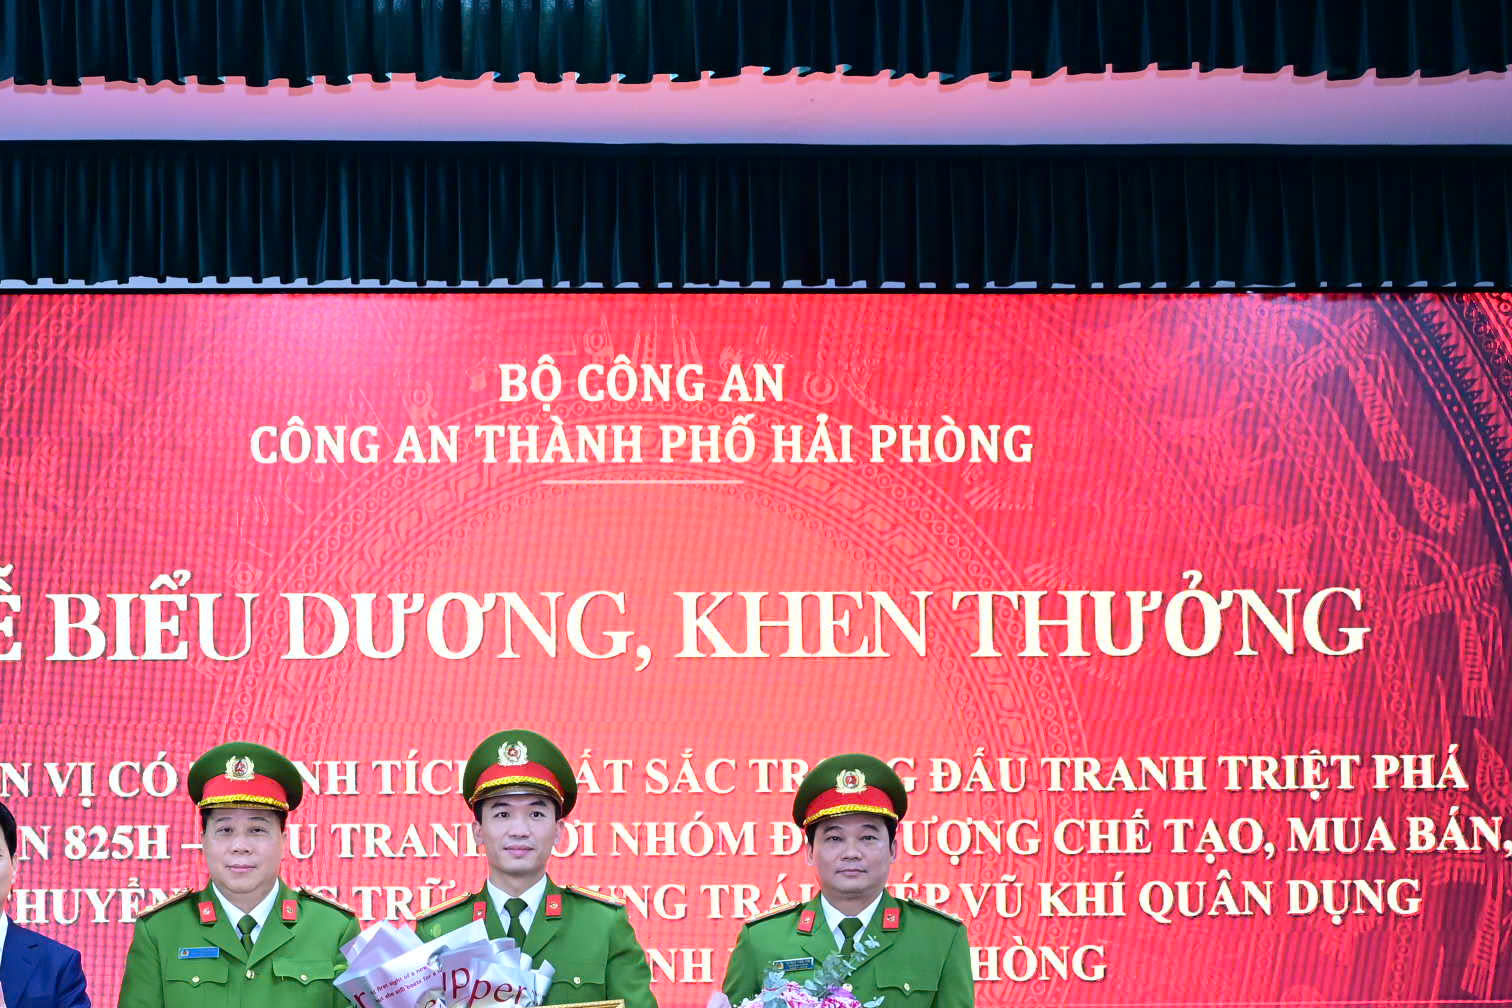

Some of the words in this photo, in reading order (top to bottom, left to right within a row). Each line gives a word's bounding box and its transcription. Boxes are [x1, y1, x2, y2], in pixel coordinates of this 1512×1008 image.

[499, 354, 562, 411] BỘ
[577, 354, 705, 403] CÔNG
[718, 363, 786, 403] AN
[250, 415, 380, 464] CÔNG
[393, 425, 460, 464] AN
[474, 414, 643, 464] THÀNH
[659, 413, 756, 463] PHỐ
[771, 413, 854, 463] HẢI
[869, 415, 1033, 463] PHÒNG
[45, 569, 260, 662] BIỂU
[279, 590, 652, 673] DƯƠNG,
[673, 590, 934, 659] KHEN
[952, 569, 1372, 658] THƯỞNG
[43, 761, 96, 808] VỊ
[108, 751, 178, 797] CÓ
[575, 748, 633, 795] ẤT
[645, 747, 736, 795] SẮC
[748, 757, 919, 795] TRG
[929, 747, 1029, 793] ĐẤU
[1040, 756, 1207, 792] TRANH
[1217, 749, 1360, 801] TRIỆT
[1372, 743, 1470, 790] PHÁ
[17, 825, 52, 861] N
[64, 824, 172, 860] 825H
[610, 811, 758, 858] NHÓM
[901, 815, 1042, 866] ƯỢNG
[1053, 808, 1153, 856] CHẾ
[1163, 817, 1275, 865] TẠO,
[1287, 815, 1396, 854] MUA
[1406, 805, 1512, 858] BÁN,
[11, 877, 190, 923] HUYỂ
[958, 874, 1025, 920] VŨ
[1036, 870, 1127, 918] KHÍ
[1138, 869, 1274, 925] QUÂN
[1286, 878, 1423, 926] DỤNG
[973, 935, 1107, 983] HÒNG
